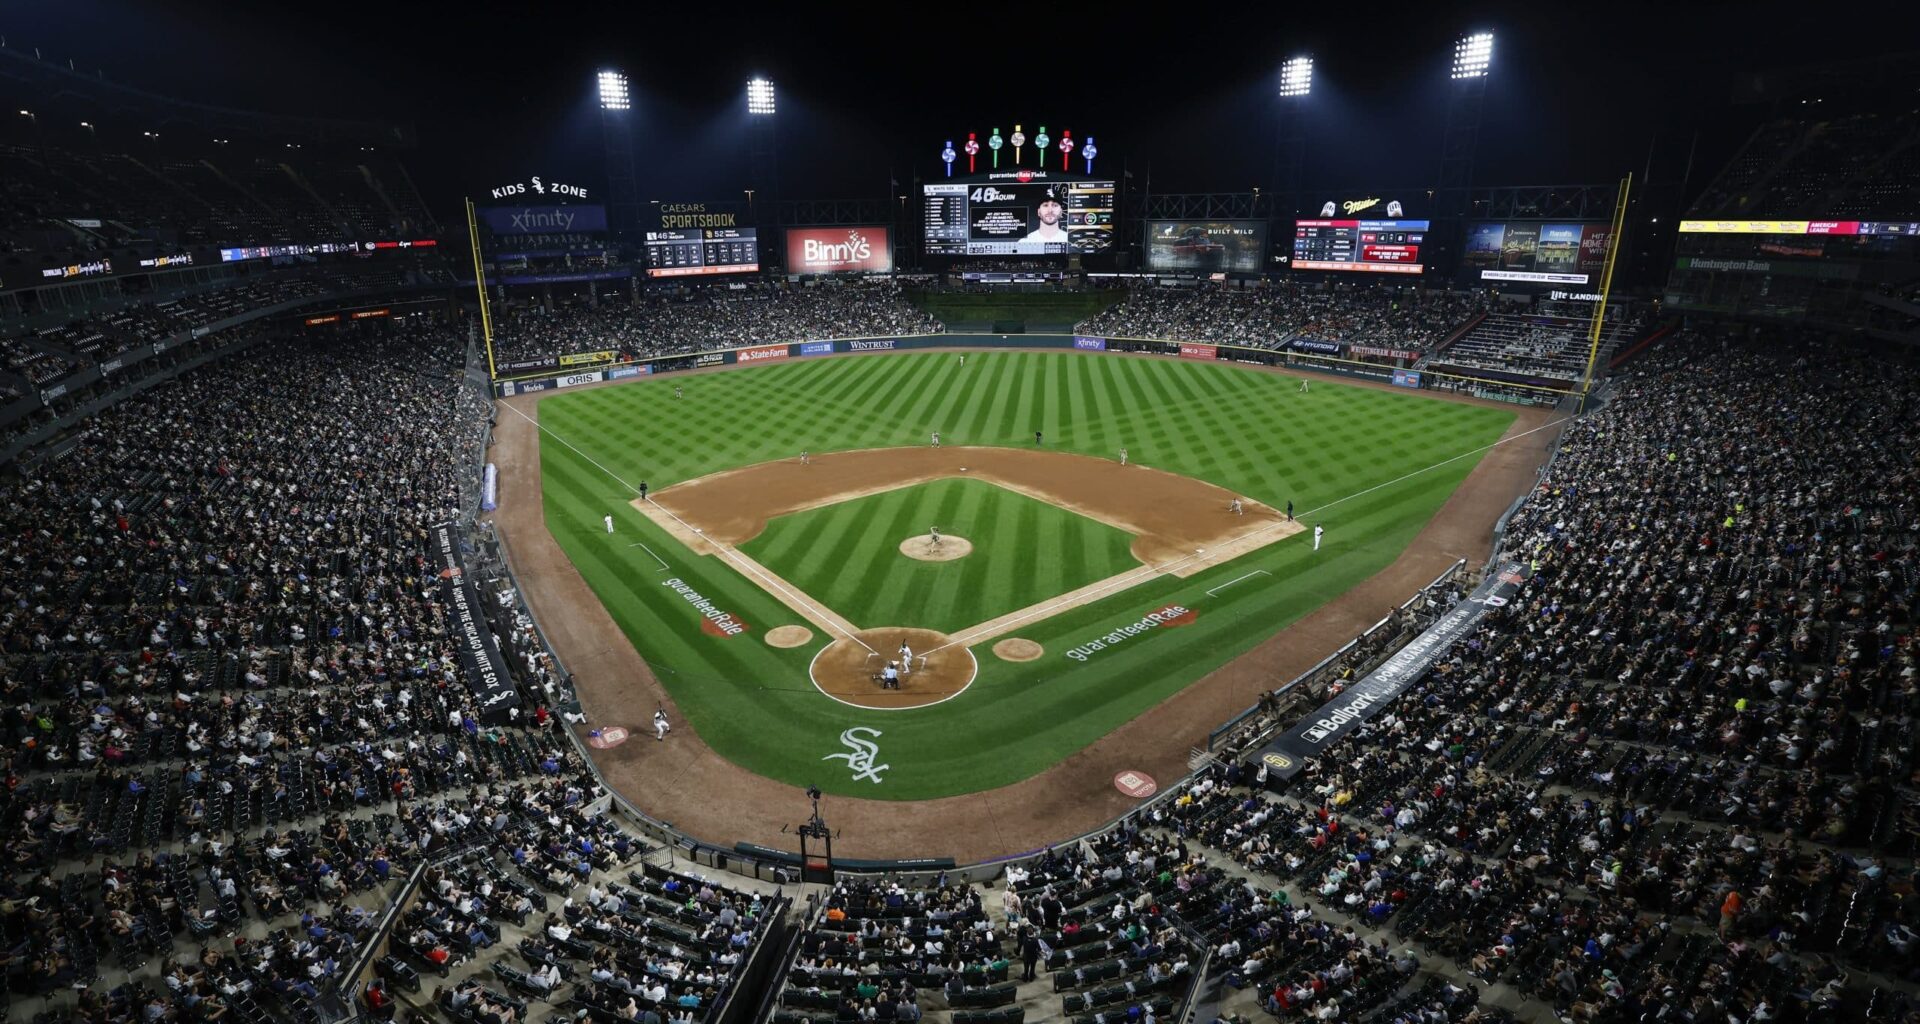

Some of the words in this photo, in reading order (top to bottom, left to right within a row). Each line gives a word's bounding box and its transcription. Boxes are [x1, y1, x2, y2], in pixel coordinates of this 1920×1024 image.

[492, 183, 526, 199] KIDS
[551, 183, 588, 198] ZONE
[660, 203, 706, 213] CAESARS
[1343, 198, 1380, 215] Miller
[511, 208, 575, 232] xfinity
[661, 214, 736, 228] SPORTSBOOK
[804, 236, 871, 262] Binny's
[1582, 239, 1604, 248] HOME
[1690, 258, 1746, 271] Huntington
[1746, 260, 1770, 271] Bank
[729, 282, 747, 290] Modelo
[1551, 290, 1568, 300] Lite
[850, 340, 895, 349] WINTRUST
[1078, 337, 1100, 349] xfinity
[1304, 341, 1335, 350] HYUNDAI
[1350, 345, 1389, 357] WHITTINGHAM
[1391, 350, 1409, 359] MEATS
[567, 374, 593, 385] ORIS
[523, 383, 545, 393] Modelo
[452, 587, 465, 602] HOME
[457, 601, 468, 611] OF
[459, 610, 472, 624] THE
[463, 622, 482, 650] CHICAGO
[474, 649, 492, 673] WHITE
[483, 671, 500, 690] SOX
[1317, 690, 1382, 733] Ballpark
[1375, 643, 1425, 682] DOWNLOAD
[1425, 634, 1441, 648] AND
[1132, 783, 1154, 797] TOYOTA
